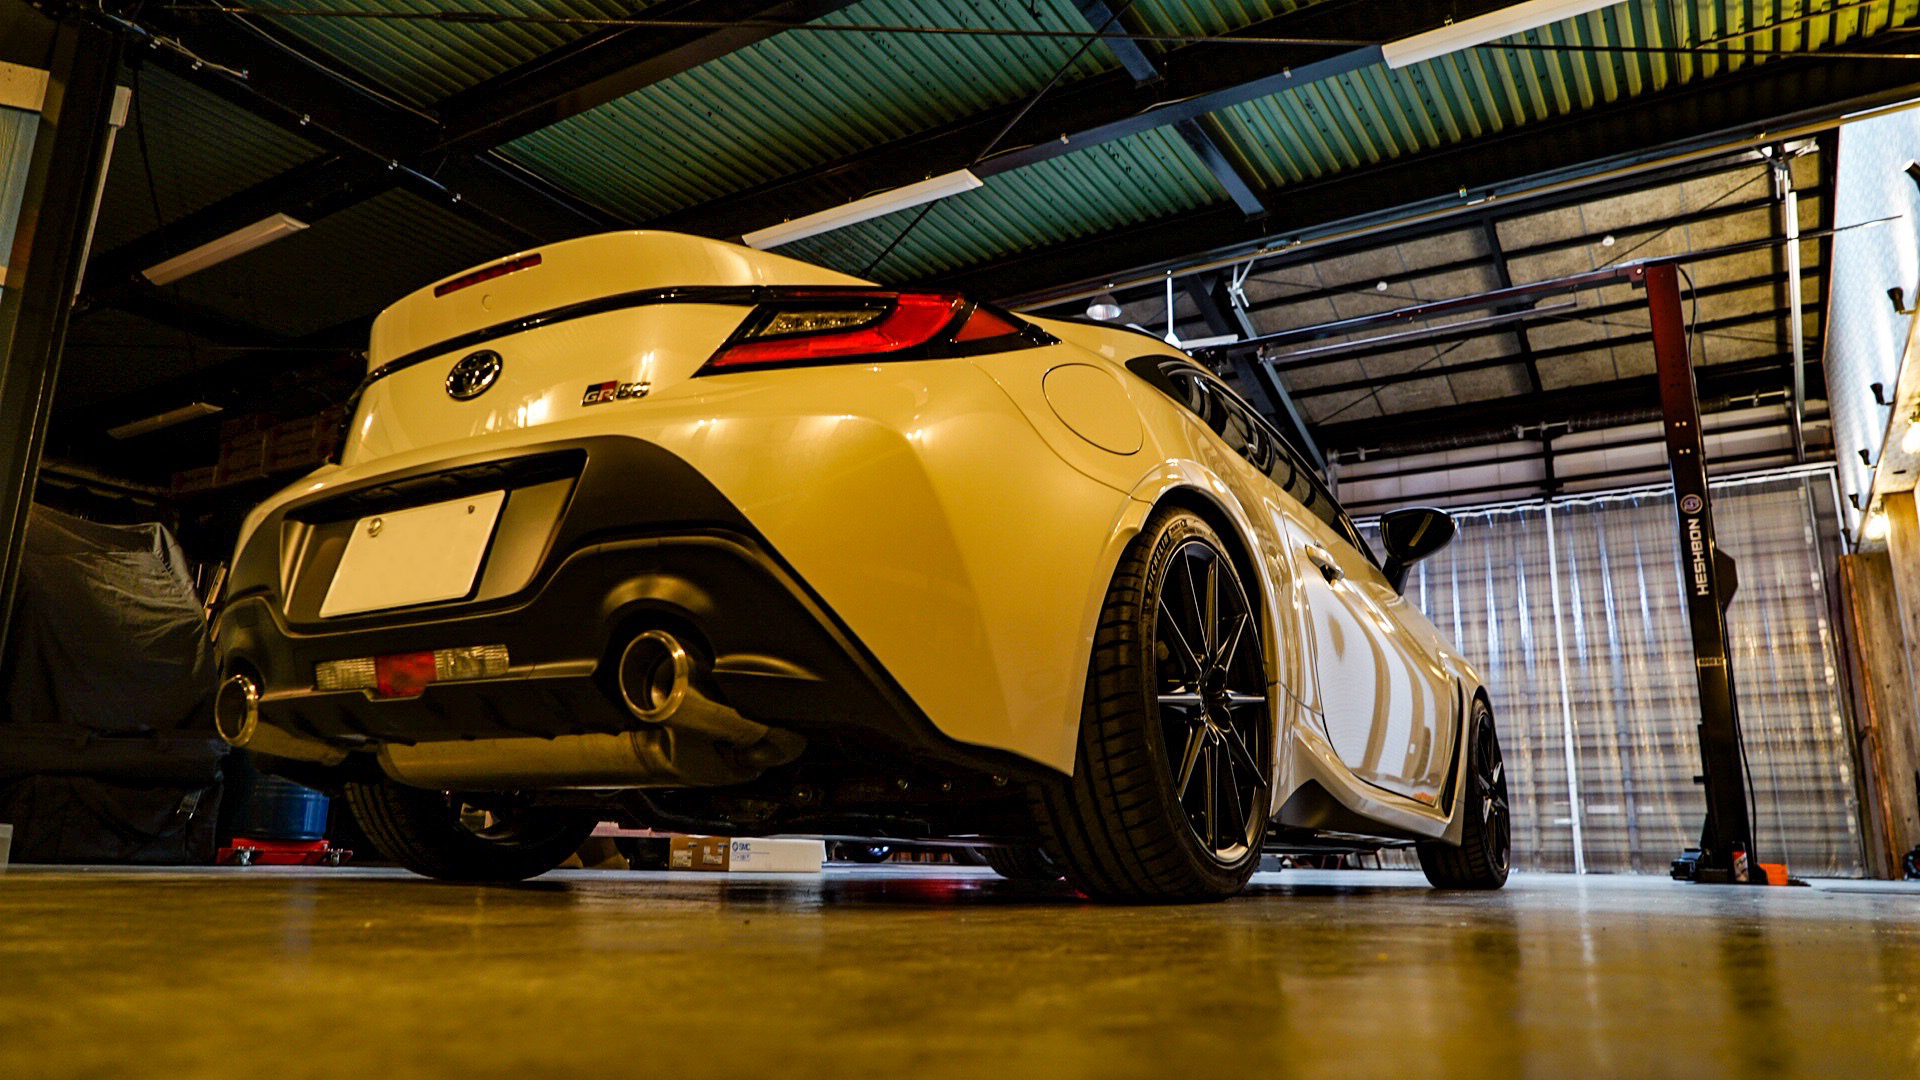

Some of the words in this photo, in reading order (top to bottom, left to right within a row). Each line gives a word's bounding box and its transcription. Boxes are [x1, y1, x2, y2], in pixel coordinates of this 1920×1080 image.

[1147, 533, 1169, 594] MICHELIN
[1687, 517, 1710, 596] HESHBON
[738, 842, 751, 851] SMC
